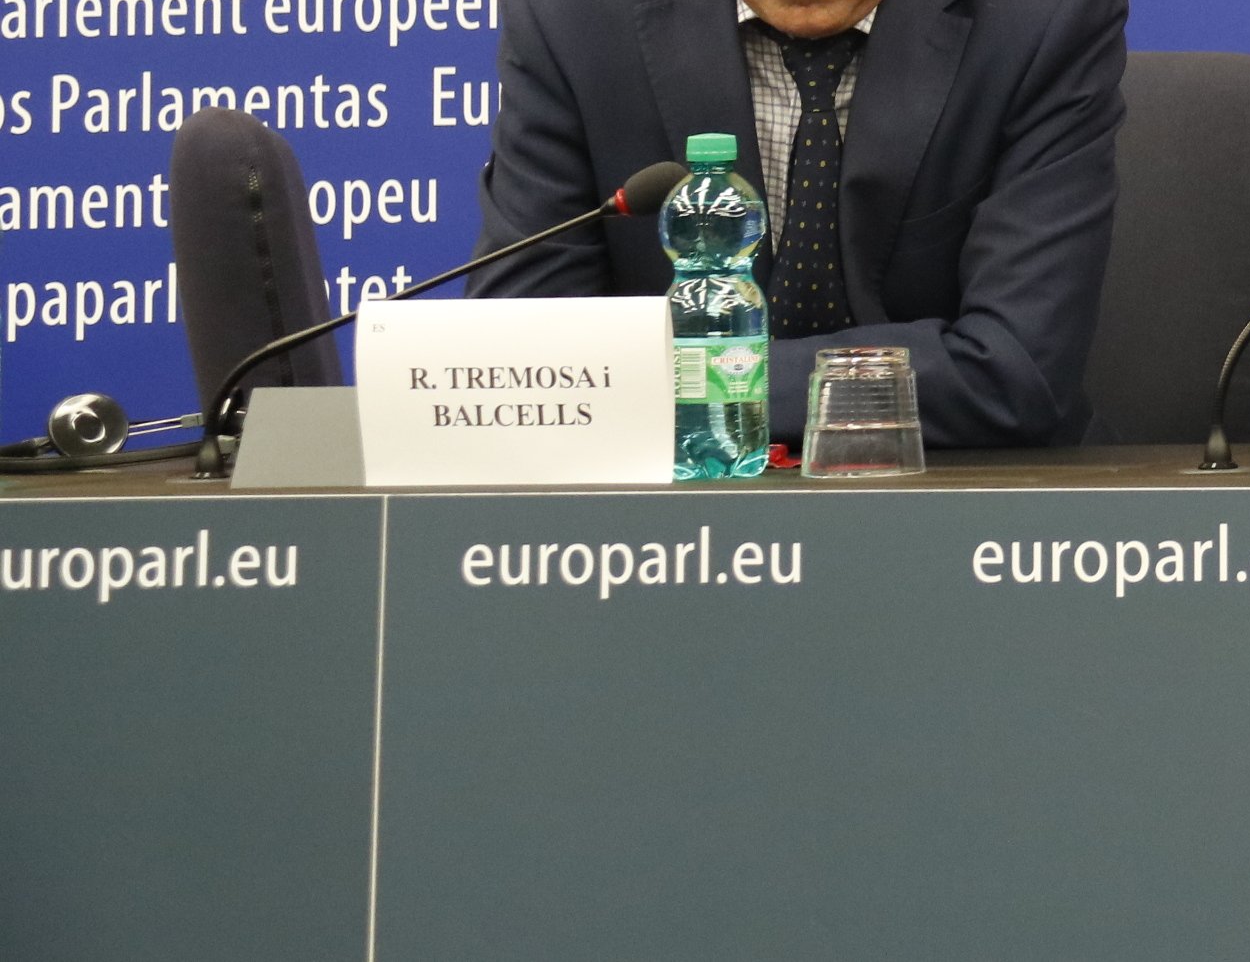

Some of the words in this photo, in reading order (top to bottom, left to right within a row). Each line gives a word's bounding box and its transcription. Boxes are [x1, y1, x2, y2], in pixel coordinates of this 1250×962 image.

[52, 72, 388, 133] Parlamentas
[433, 66, 503, 126] Eu
[0, 174, 168, 231] ament
[308, 178, 437, 240] opeu
[372, 323, 386, 334] ES
[409, 367, 437, 390] R.
[444, 366, 597, 390] TREMOSA
[603, 365, 611, 388] i
[432, 402, 593, 427] BALCELLS
[1, 529, 297, 603] uroparl.eu
[461, 525, 802, 600] europarl.eu
